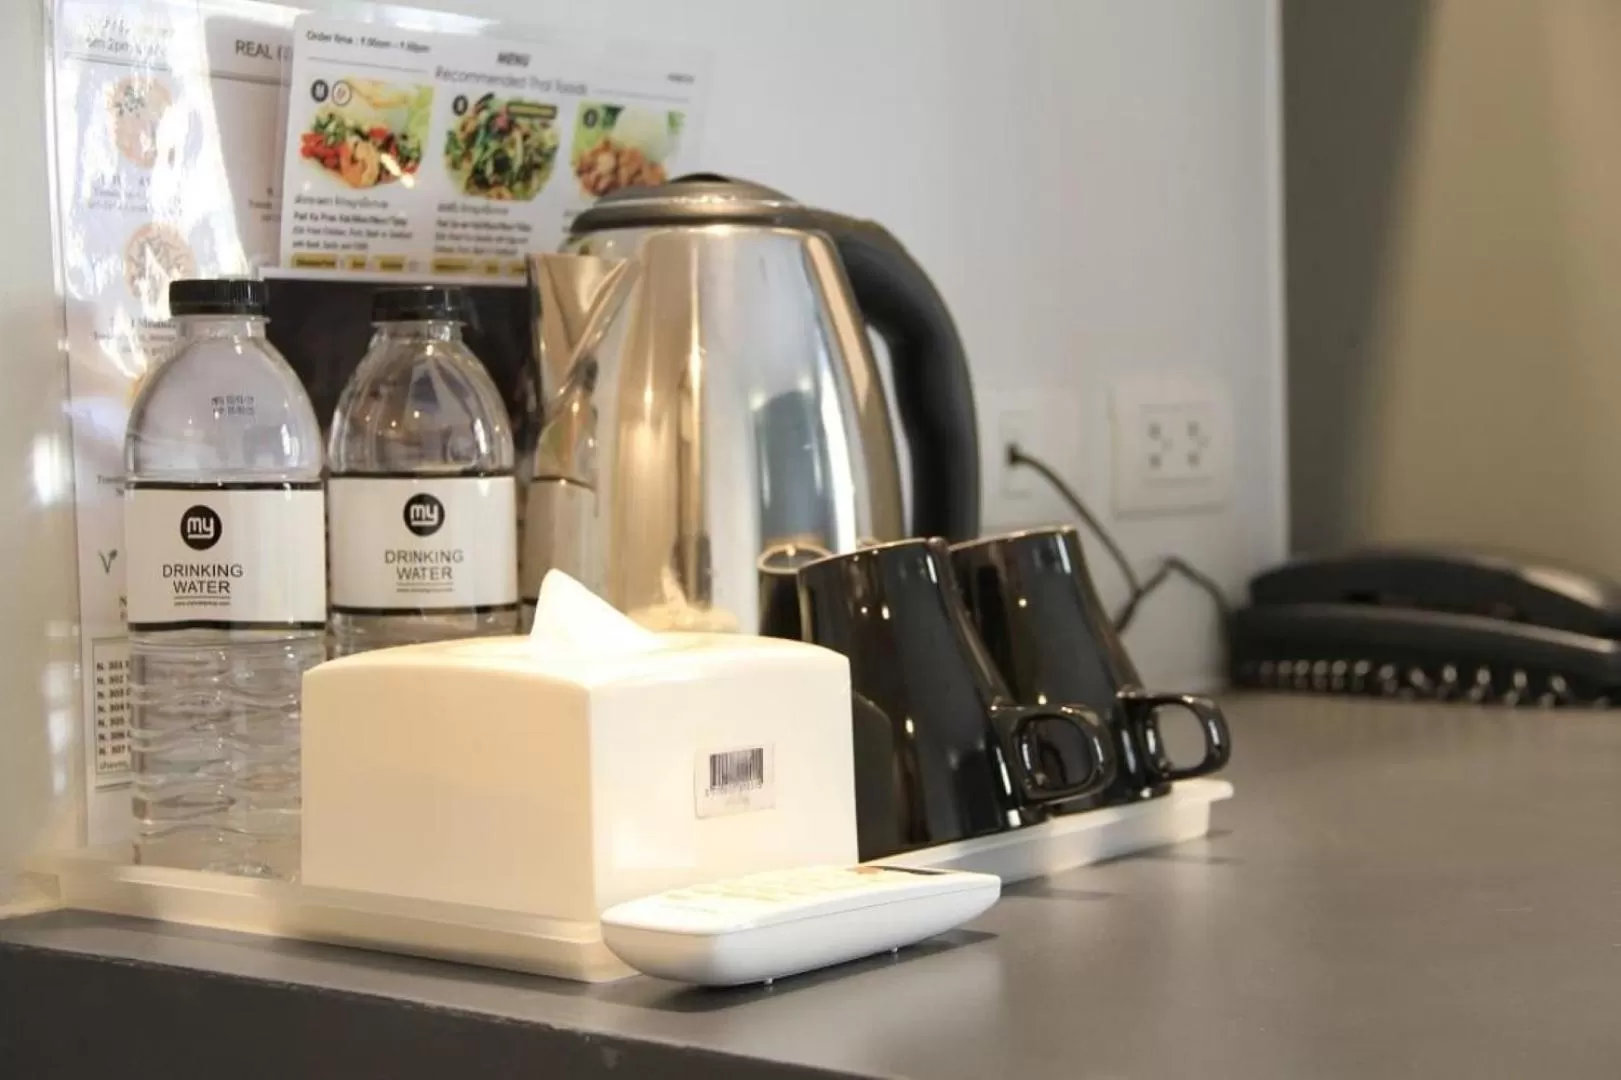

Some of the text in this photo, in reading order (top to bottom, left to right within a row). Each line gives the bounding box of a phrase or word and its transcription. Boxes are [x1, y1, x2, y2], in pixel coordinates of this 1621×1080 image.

[234, 39, 273, 60] REAL
[498, 52, 531, 67] MENU
[435, 65, 526, 89] Recommended
[410, 503, 439, 527] my
[187, 516, 214, 540] my
[384, 549, 465, 565] DRINKING
[162, 563, 244, 578] DRINKING
[396, 566, 454, 581] WATER
[172, 580, 231, 594] WATER
